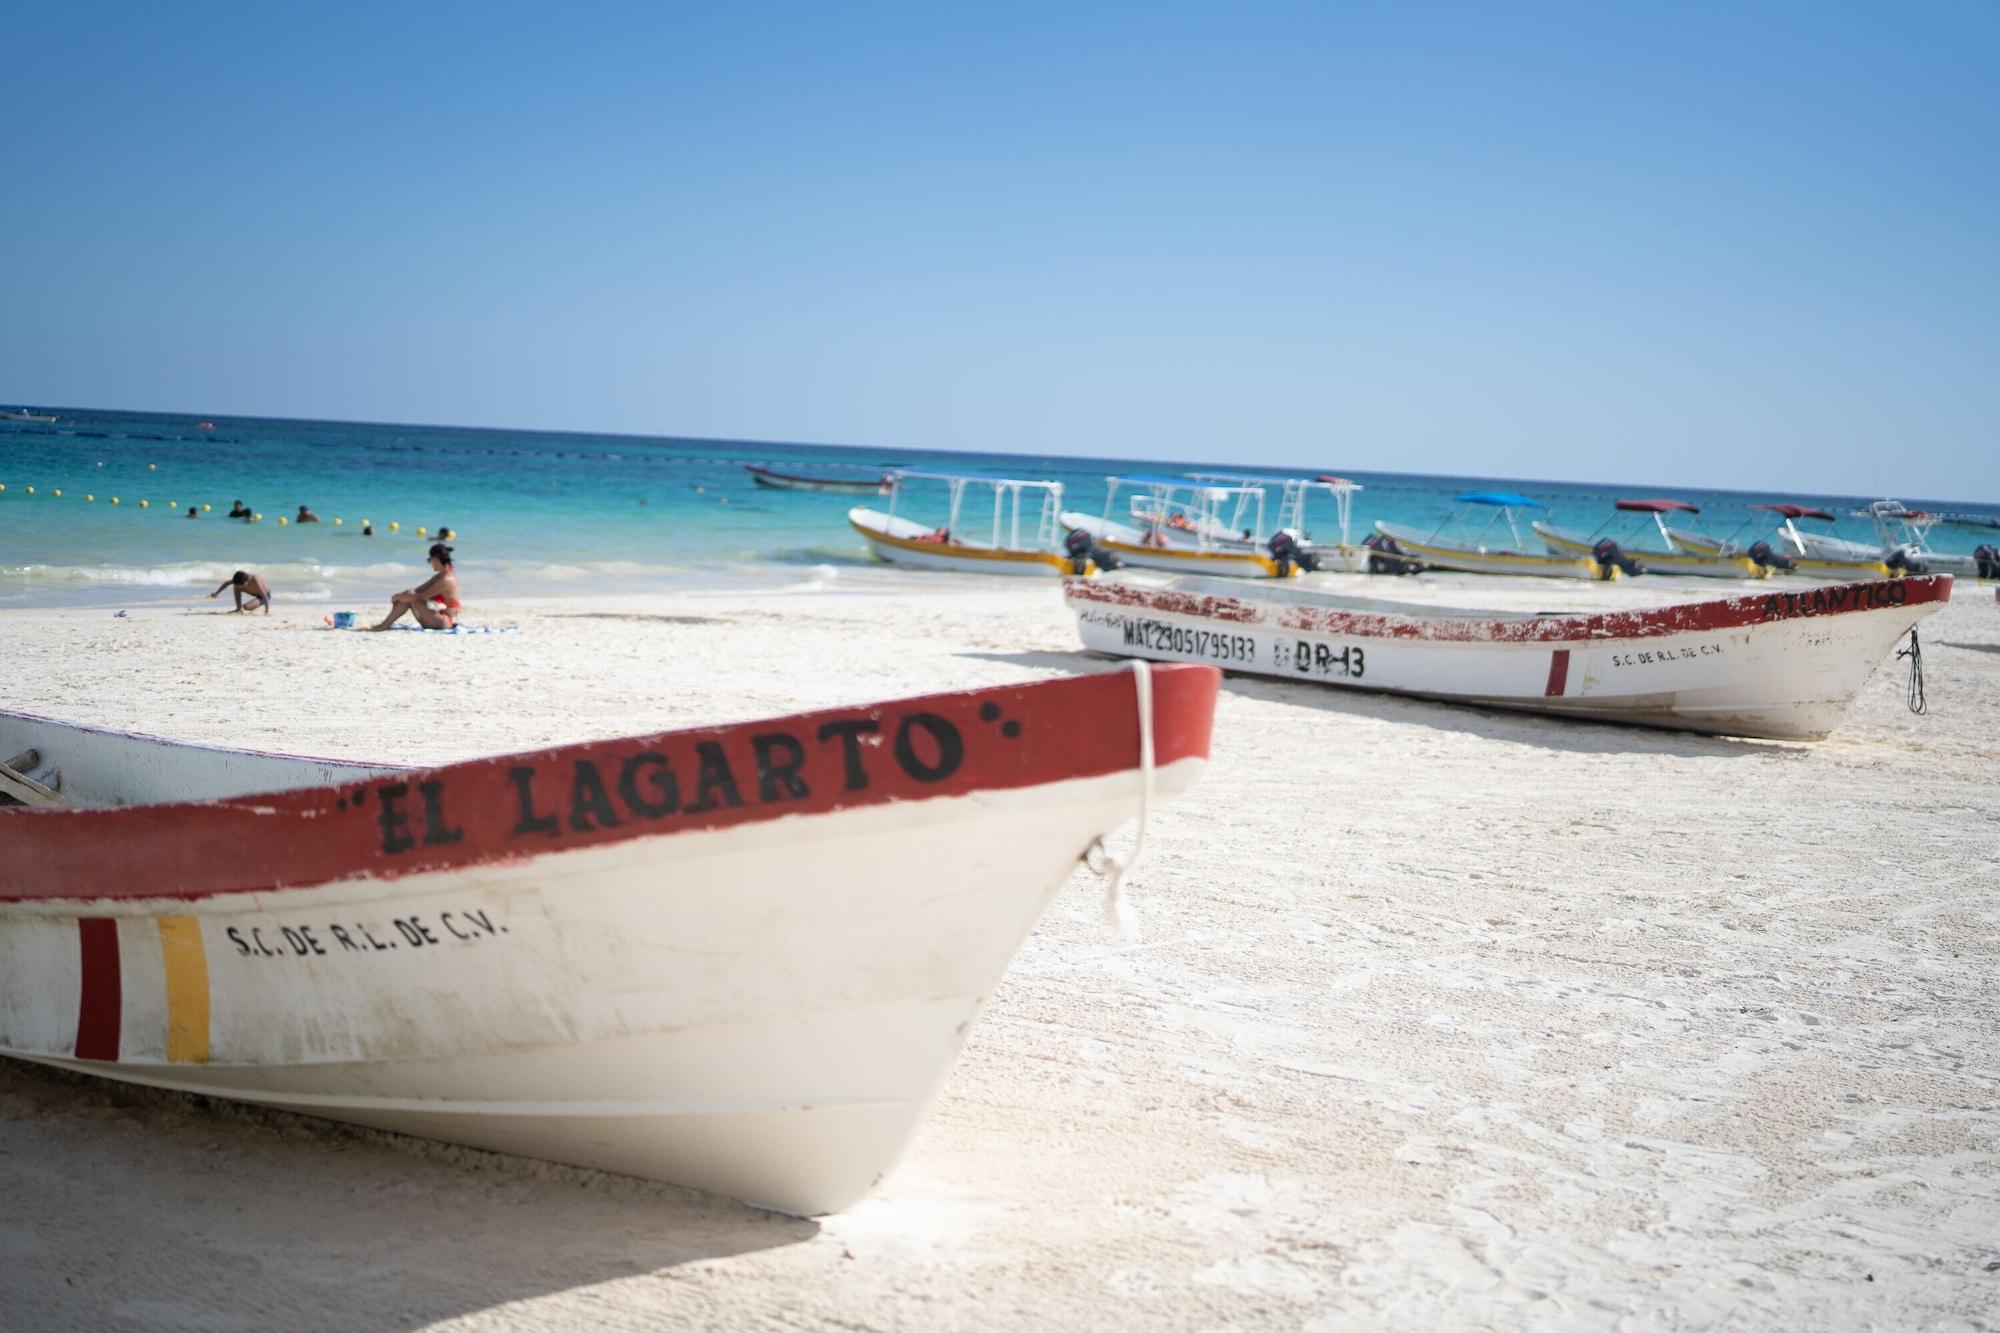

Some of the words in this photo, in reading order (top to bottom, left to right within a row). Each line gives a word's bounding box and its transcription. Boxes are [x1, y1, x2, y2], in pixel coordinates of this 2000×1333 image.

[1764, 581, 1906, 621] ATLANTICO
[1612, 655, 1636, 667] S.C.
[1638, 652, 1654, 664] DE
[226, 926, 283, 957] S.C.
[281, 926, 326, 956] DE
[329, 923, 397, 952] R.L.
[393, 916, 438, 947] DE
[440, 910, 509, 940] C.V.
